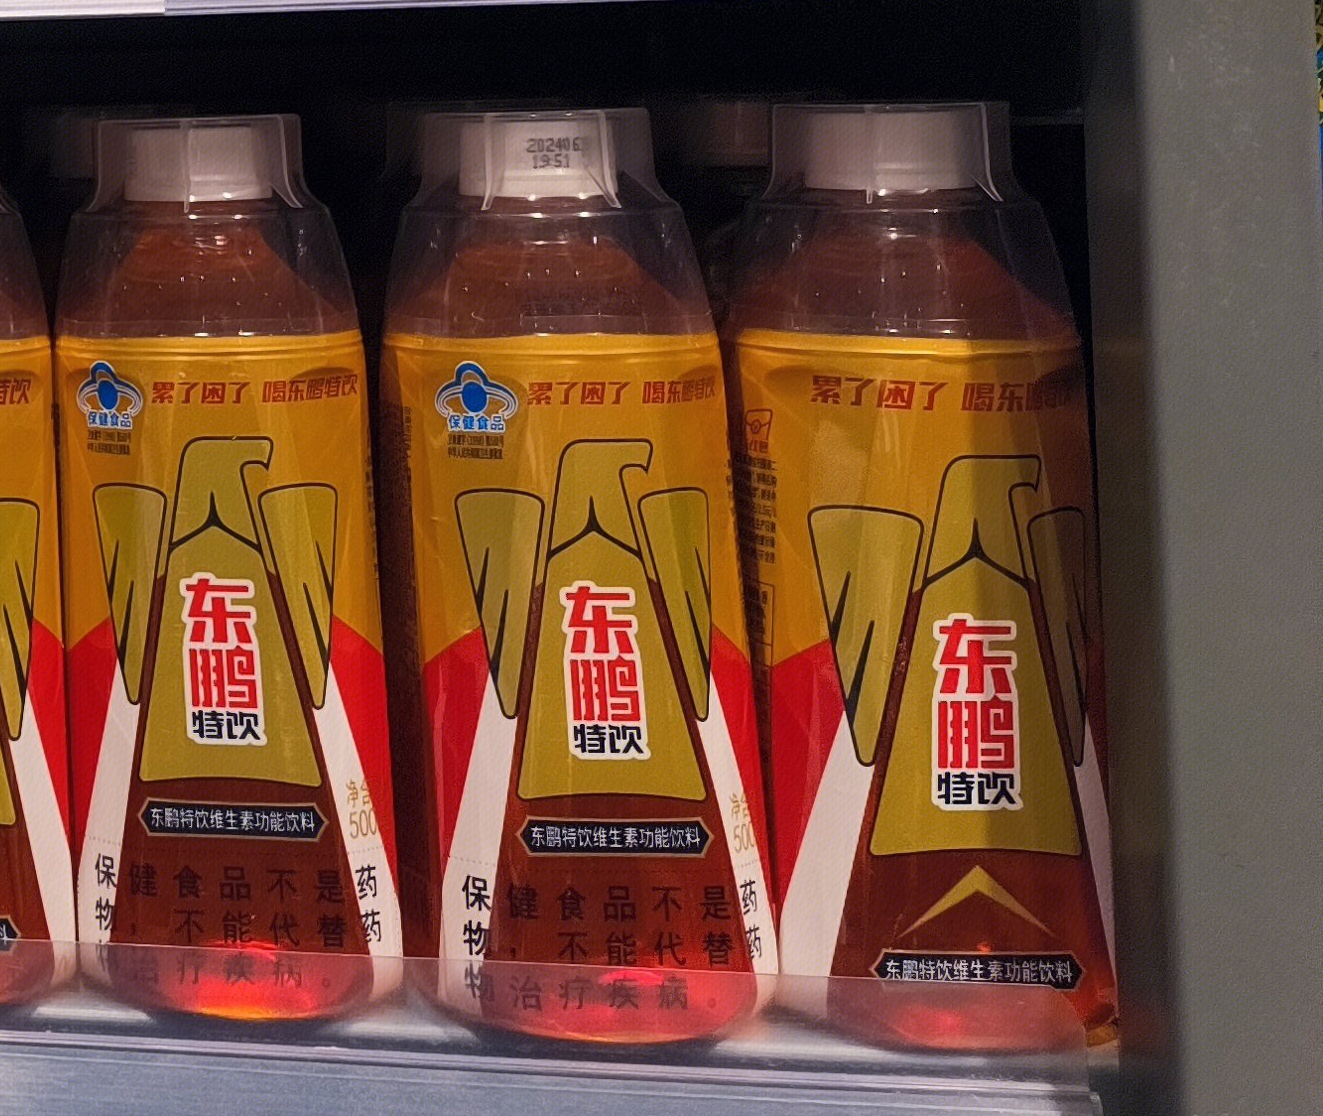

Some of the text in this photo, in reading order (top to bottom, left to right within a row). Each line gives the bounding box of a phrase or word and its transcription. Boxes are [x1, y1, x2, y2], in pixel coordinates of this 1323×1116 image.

[151, 373, 358, 406] 累了困了 喝东鹏特饮
[527, 379, 629, 406] 累了困了
[810, 375, 948, 412] 累了困了
[448, 414, 505, 431] 保健食品
[151, 806, 316, 835] 东鹏特饮维生素功能饮料
[530, 825, 701, 850] 东鹏特饮维生素功能饮料
[884, 957, 1074, 986] 东鹏特饮维生素功能饮料
